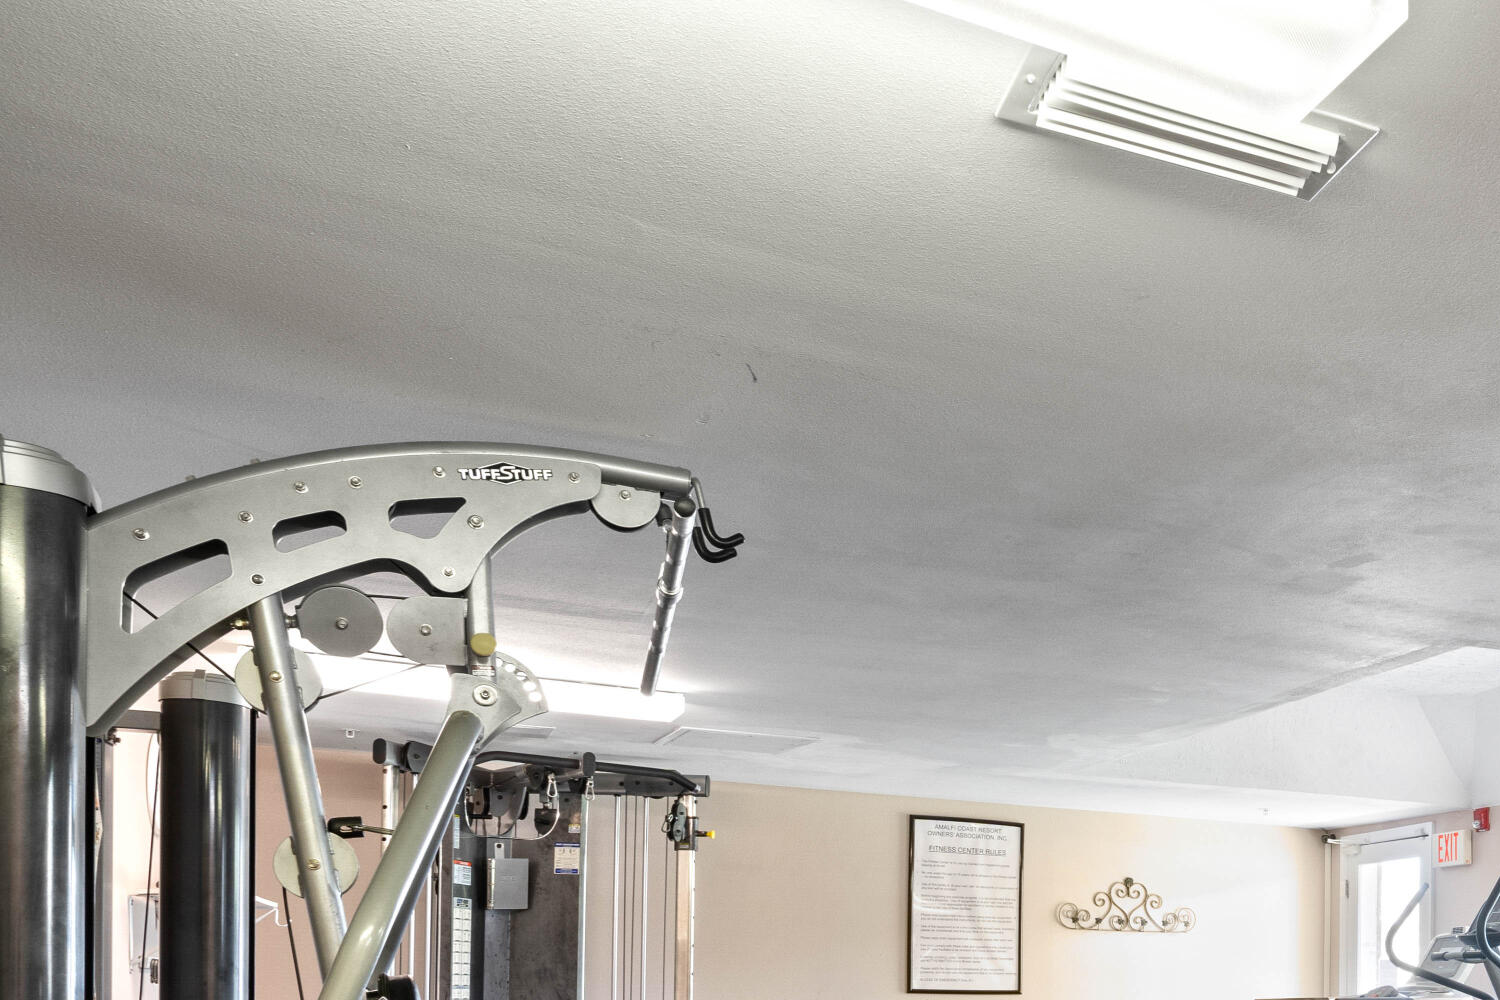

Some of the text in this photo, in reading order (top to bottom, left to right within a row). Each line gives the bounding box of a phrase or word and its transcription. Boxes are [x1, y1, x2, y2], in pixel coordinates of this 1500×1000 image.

[457, 465, 553, 481] TUFFSTUFF
[957, 825, 977, 833] COAST
[928, 844, 1007, 856] FITNESS CENTER RULES
[1438, 832, 1459, 863] EXIT
